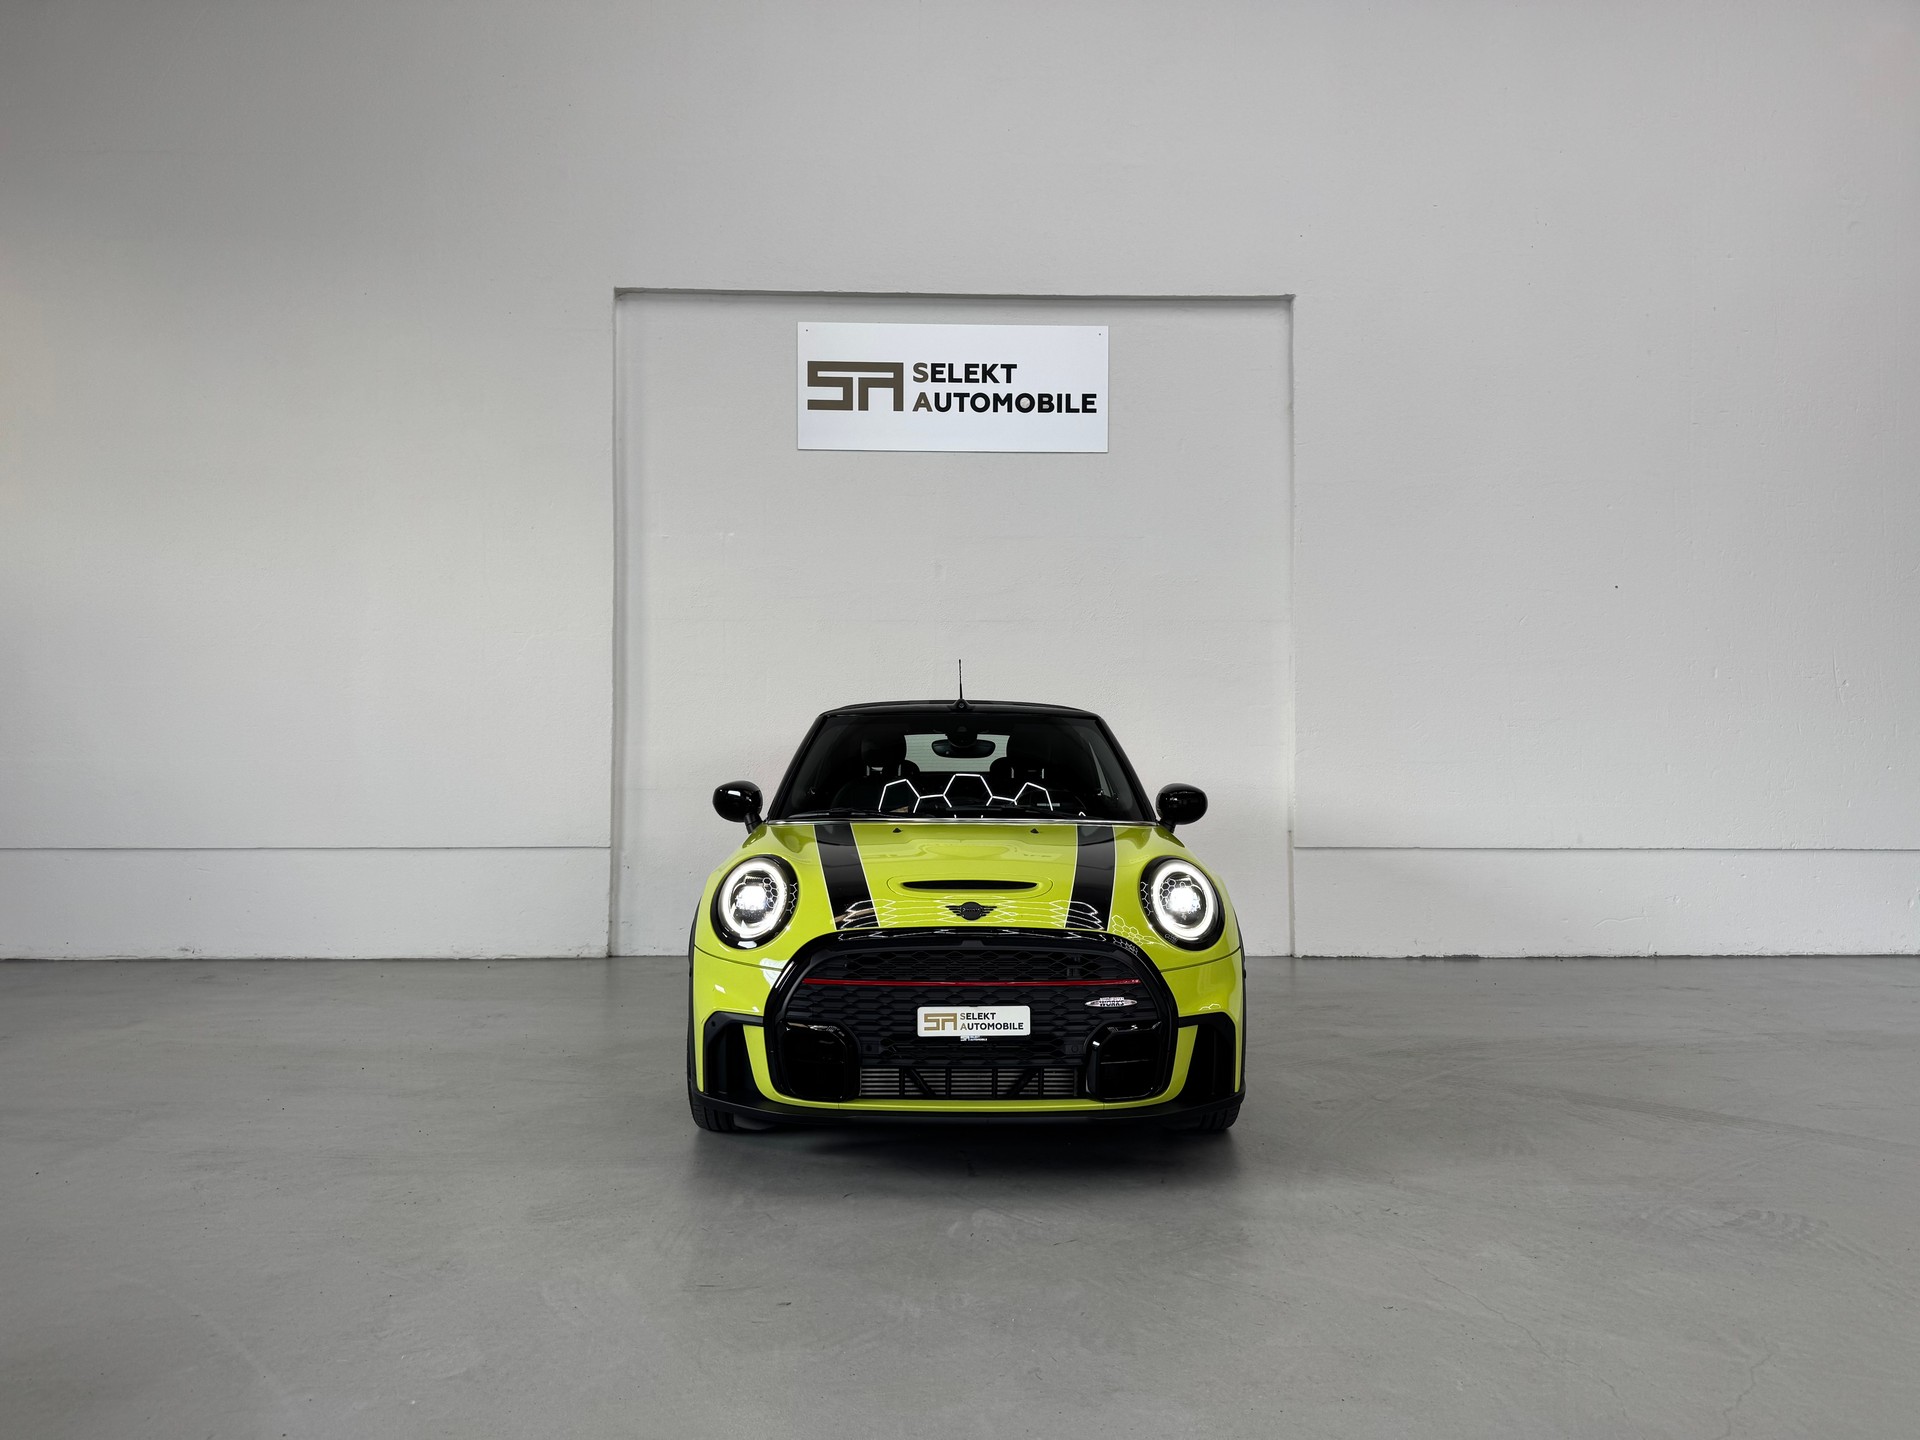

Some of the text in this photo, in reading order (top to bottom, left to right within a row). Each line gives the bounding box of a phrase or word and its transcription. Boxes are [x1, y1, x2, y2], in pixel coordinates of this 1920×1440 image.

[912, 362, 1018, 384] SELEKT
[912, 391, 1097, 413] AUTOMOBILE
[960, 1012, 996, 1020] SELEKT
[960, 1022, 1024, 1031] AUTOMOBILE
